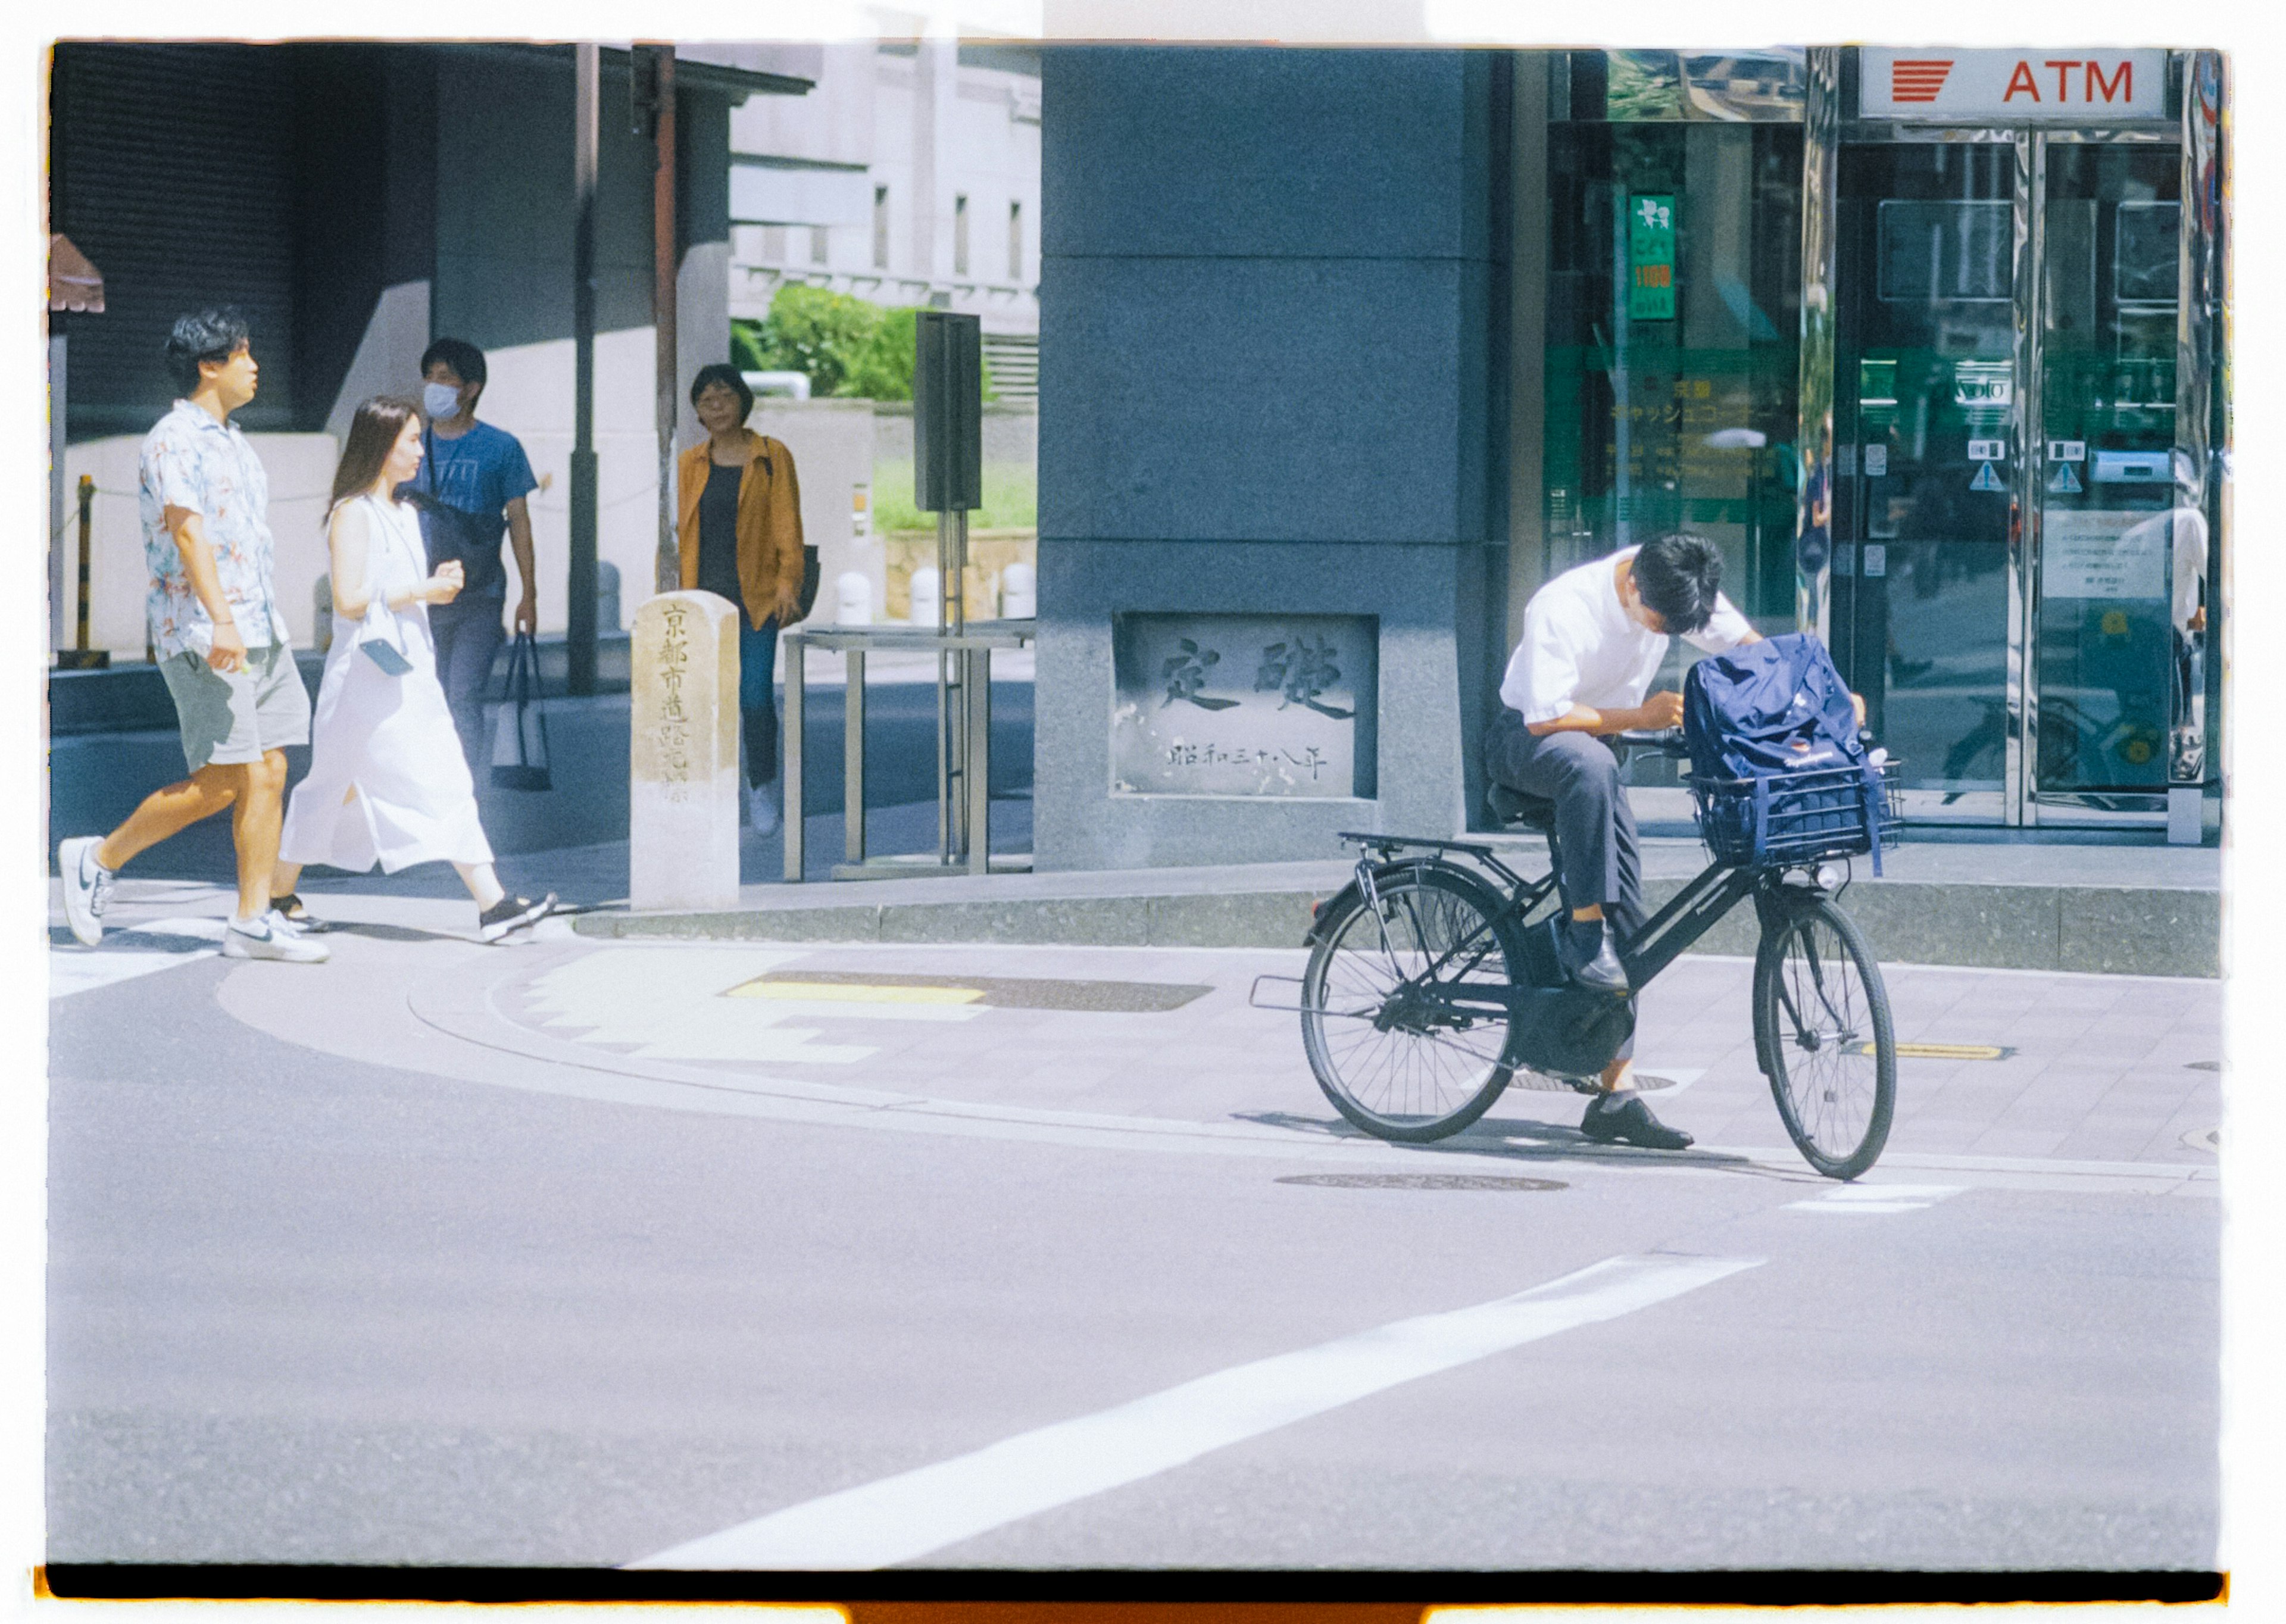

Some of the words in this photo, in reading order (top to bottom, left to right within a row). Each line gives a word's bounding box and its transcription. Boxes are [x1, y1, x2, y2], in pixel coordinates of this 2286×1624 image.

[2003, 61, 2134, 103] ATM
[1160, 633, 1357, 720] 定礎
[1167, 744, 1328, 780] 昭和三十八年
